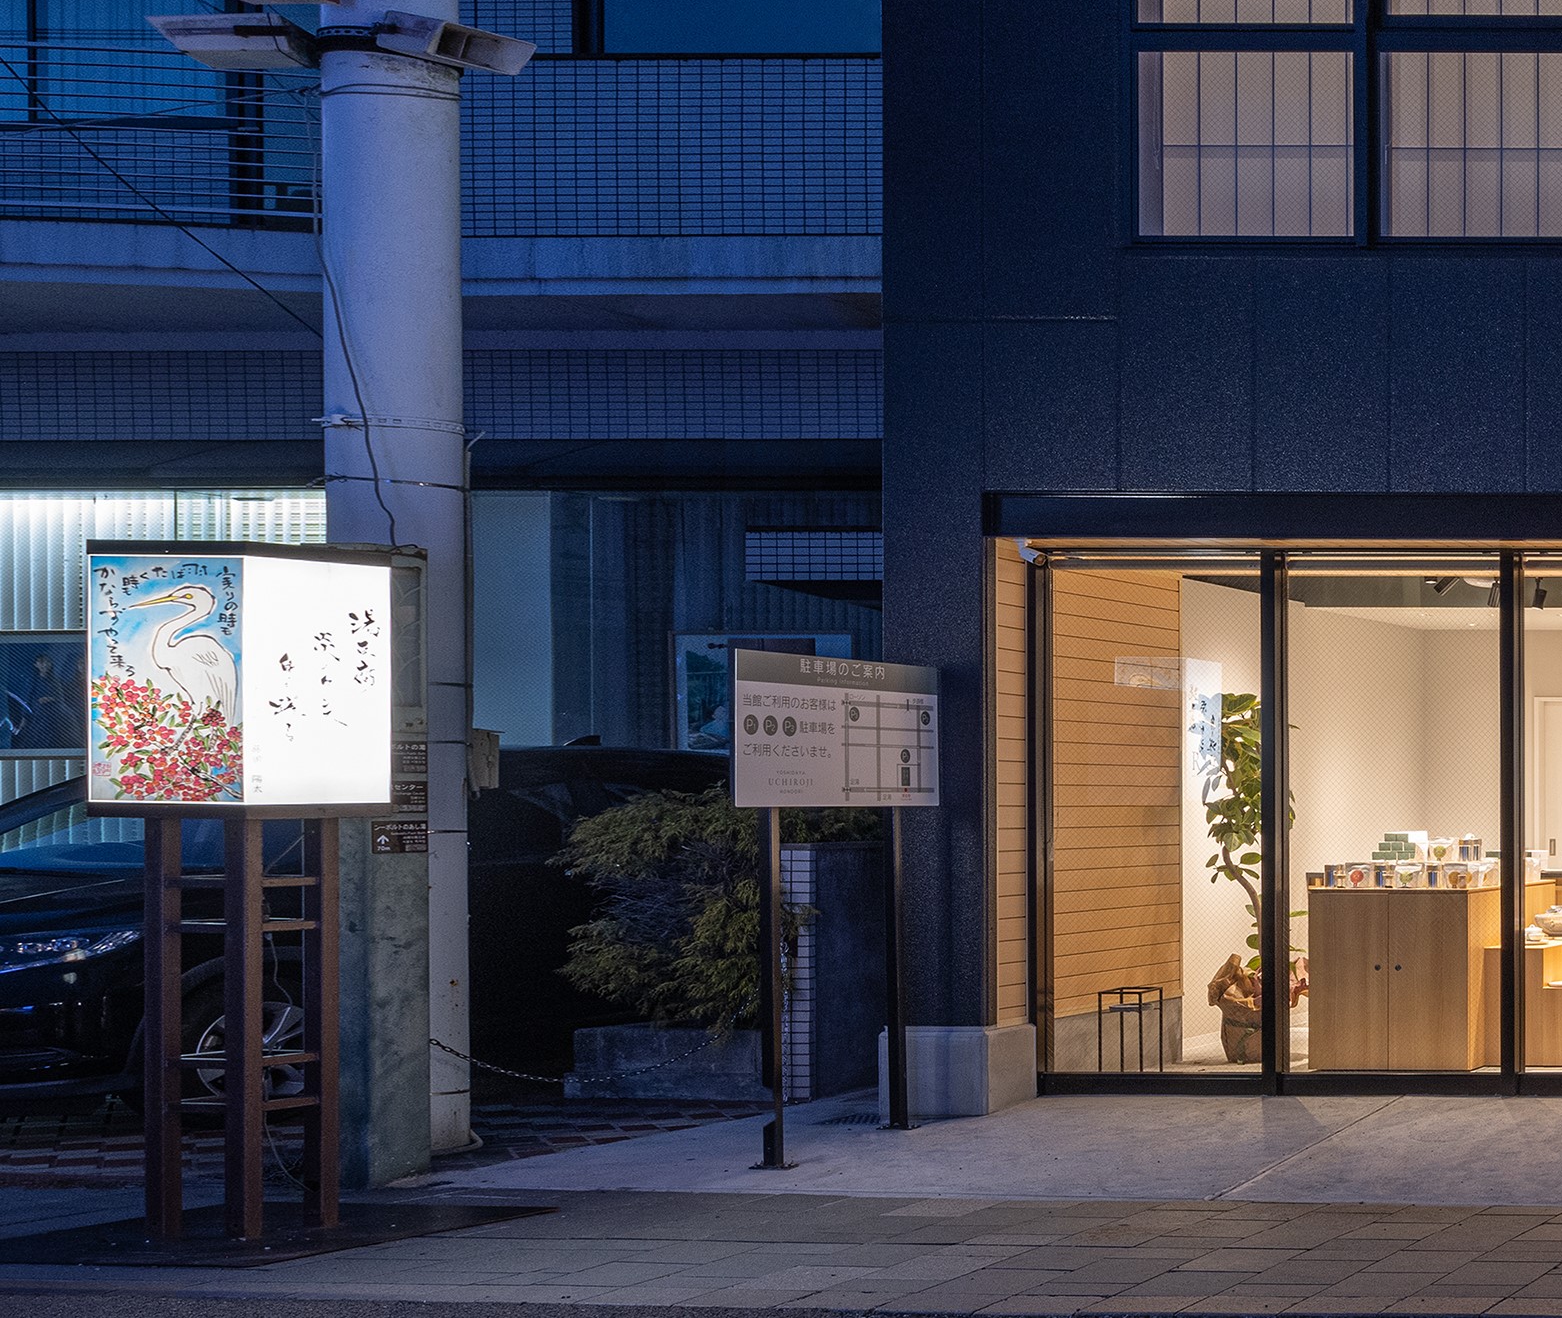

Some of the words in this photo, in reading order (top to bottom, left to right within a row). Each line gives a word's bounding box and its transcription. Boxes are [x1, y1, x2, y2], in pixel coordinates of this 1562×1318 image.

[799, 658, 885, 680] 駐車場のご案内
[742, 693, 837, 711] 当館ご利用のお客様は
[799, 721, 836, 735] 駐車場を
[742, 743, 832, 759] ご利用くださいませ。
[768, 778, 813, 788] UCHIROJI
